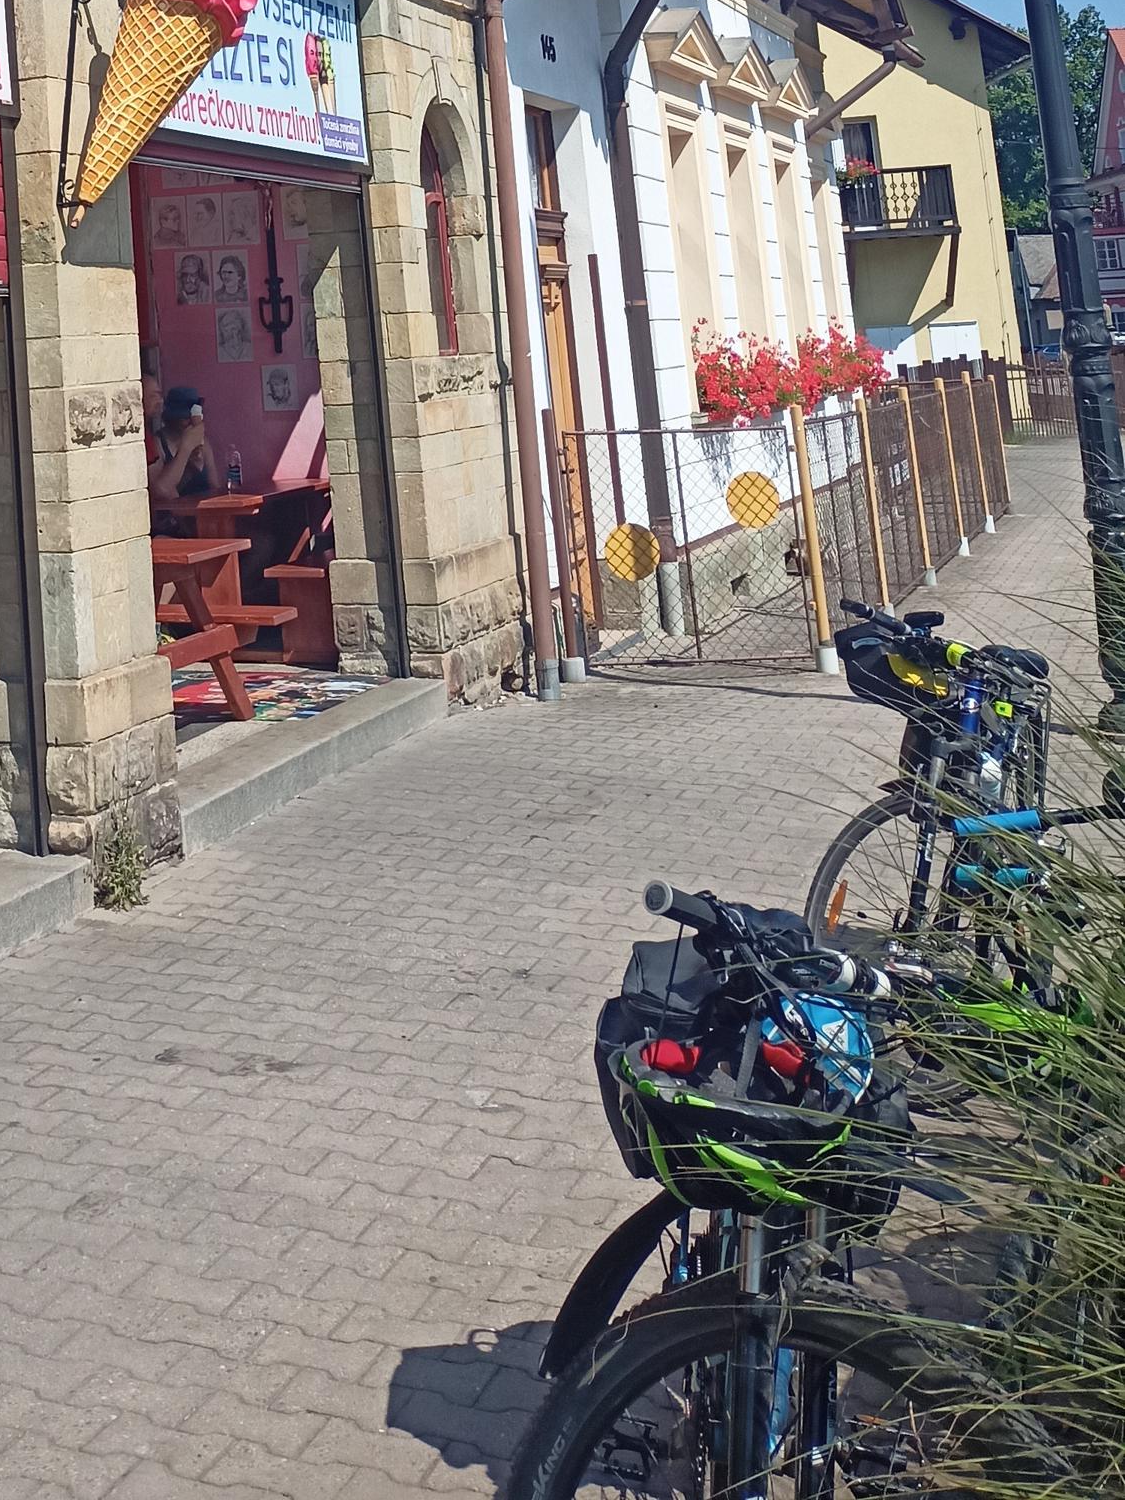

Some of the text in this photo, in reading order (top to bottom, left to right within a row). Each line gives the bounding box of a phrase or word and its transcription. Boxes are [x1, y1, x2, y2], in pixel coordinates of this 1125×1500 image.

[316, 0, 352, 44] ZEMÍ
[276, 36, 296, 86] SI
[257, 106, 321, 145] zmrzlinu!
